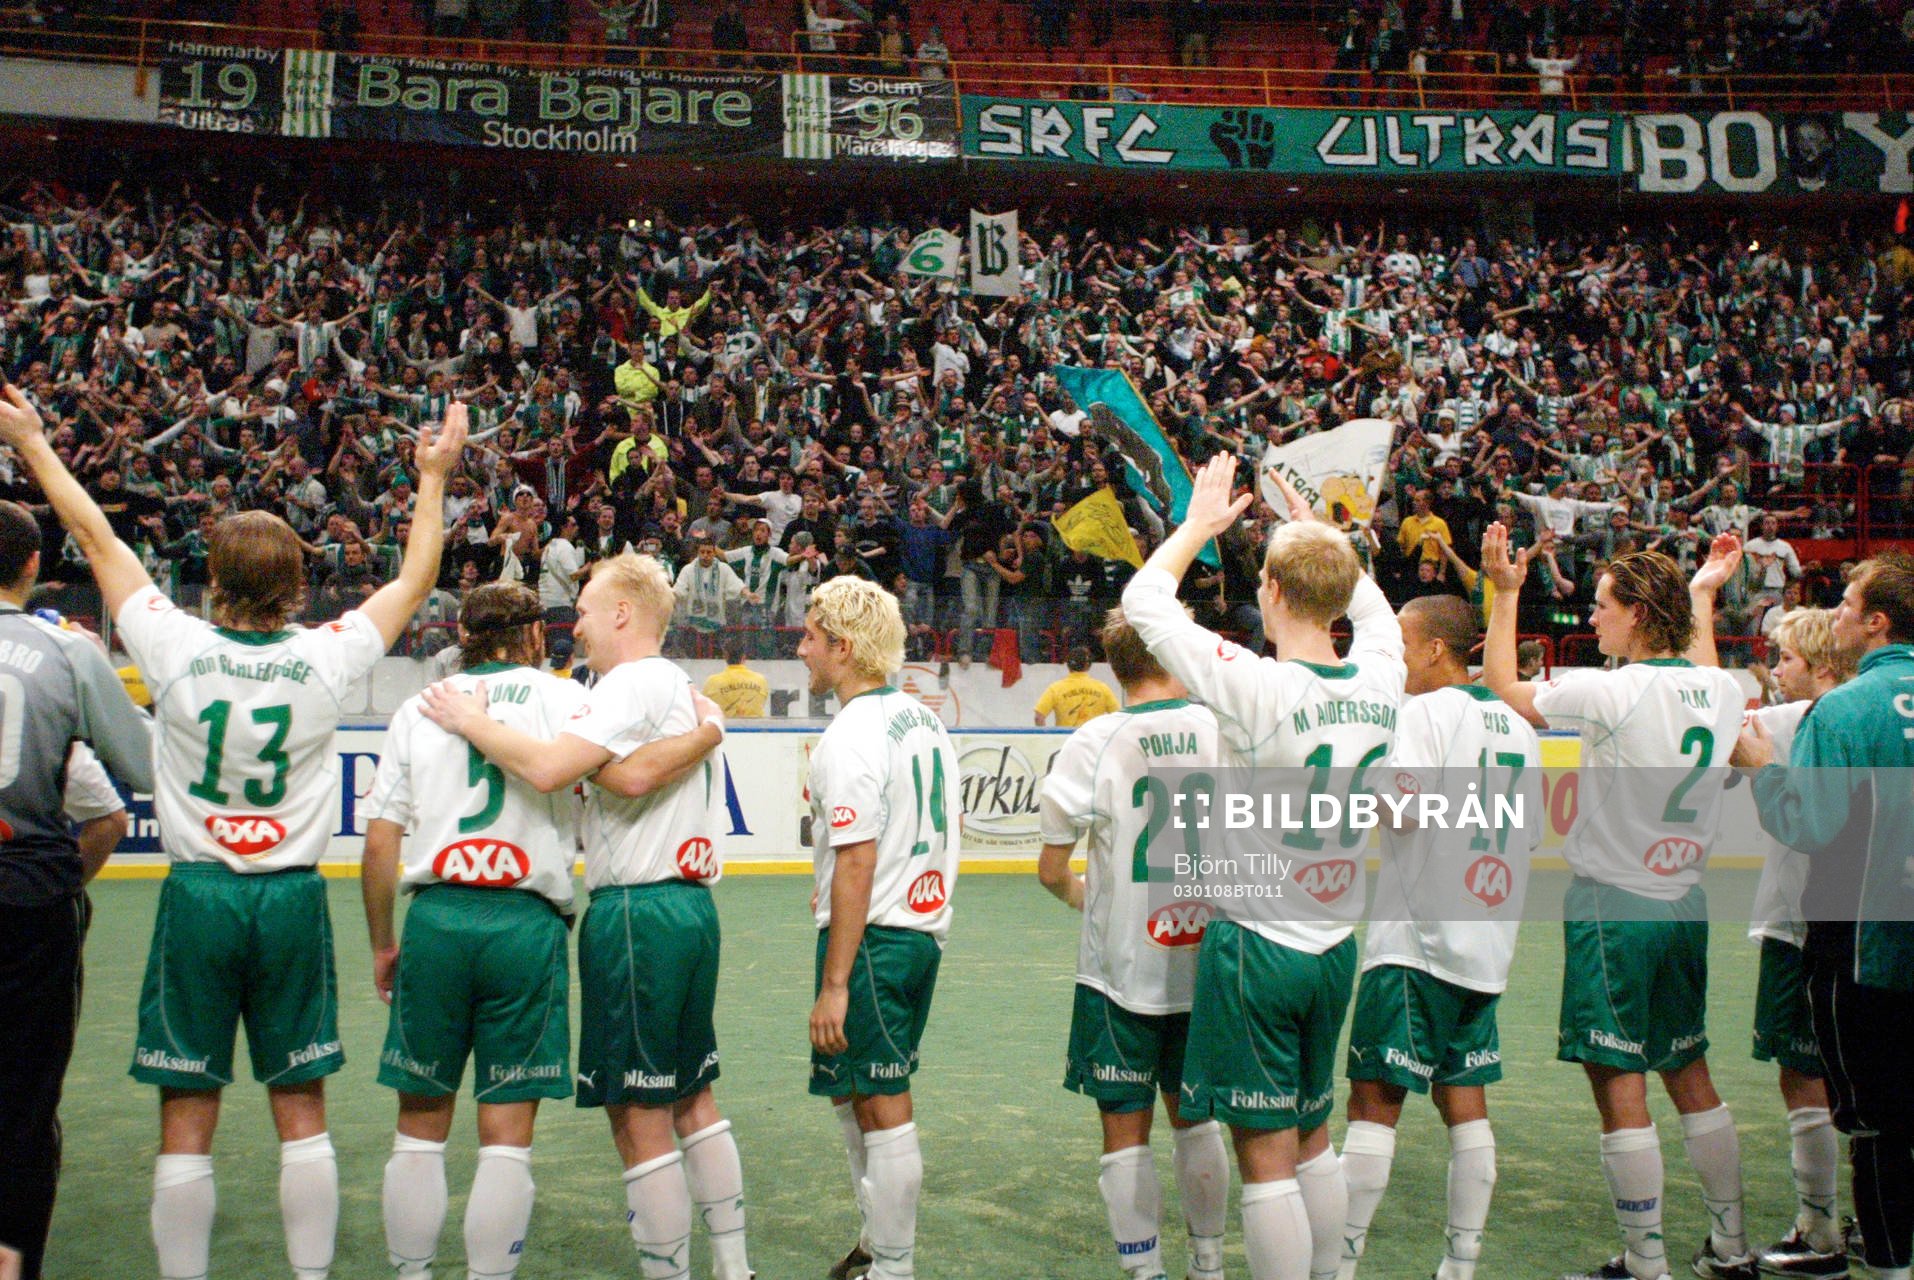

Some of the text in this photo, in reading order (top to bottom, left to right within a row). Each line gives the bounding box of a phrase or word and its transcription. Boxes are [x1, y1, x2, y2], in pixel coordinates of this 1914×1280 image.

[168, 40, 280, 65] Hammarby
[181, 60, 259, 111] 19
[357, 64, 509, 117] Bara
[539, 75, 753, 133] Bajare
[848, 78, 923, 95] Solum
[854, 95, 924, 140] 96
[979, 104, 1178, 164] SRFC
[482, 120, 638, 153] Stockholm
[1316, 115, 1610, 169] ULTRAS
[909, 241, 945, 273] 6
[1292, 707, 1311, 736] M
[189, 699, 292, 808] 13
[1138, 731, 1198, 758] POHJA
[1660, 725, 1715, 824] 2
[1281, 742, 1389, 851] 16
[1467, 746, 1526, 856] 17
[211, 819, 282, 844] AXA
[443, 848, 523, 886] AXA
[1647, 841, 1698, 869] AXA
[909, 874, 945, 905] AXA
[1301, 862, 1352, 894] AXA
[1153, 904, 1208, 938] AXA
[1589, 1029, 1645, 1055] Folksam
